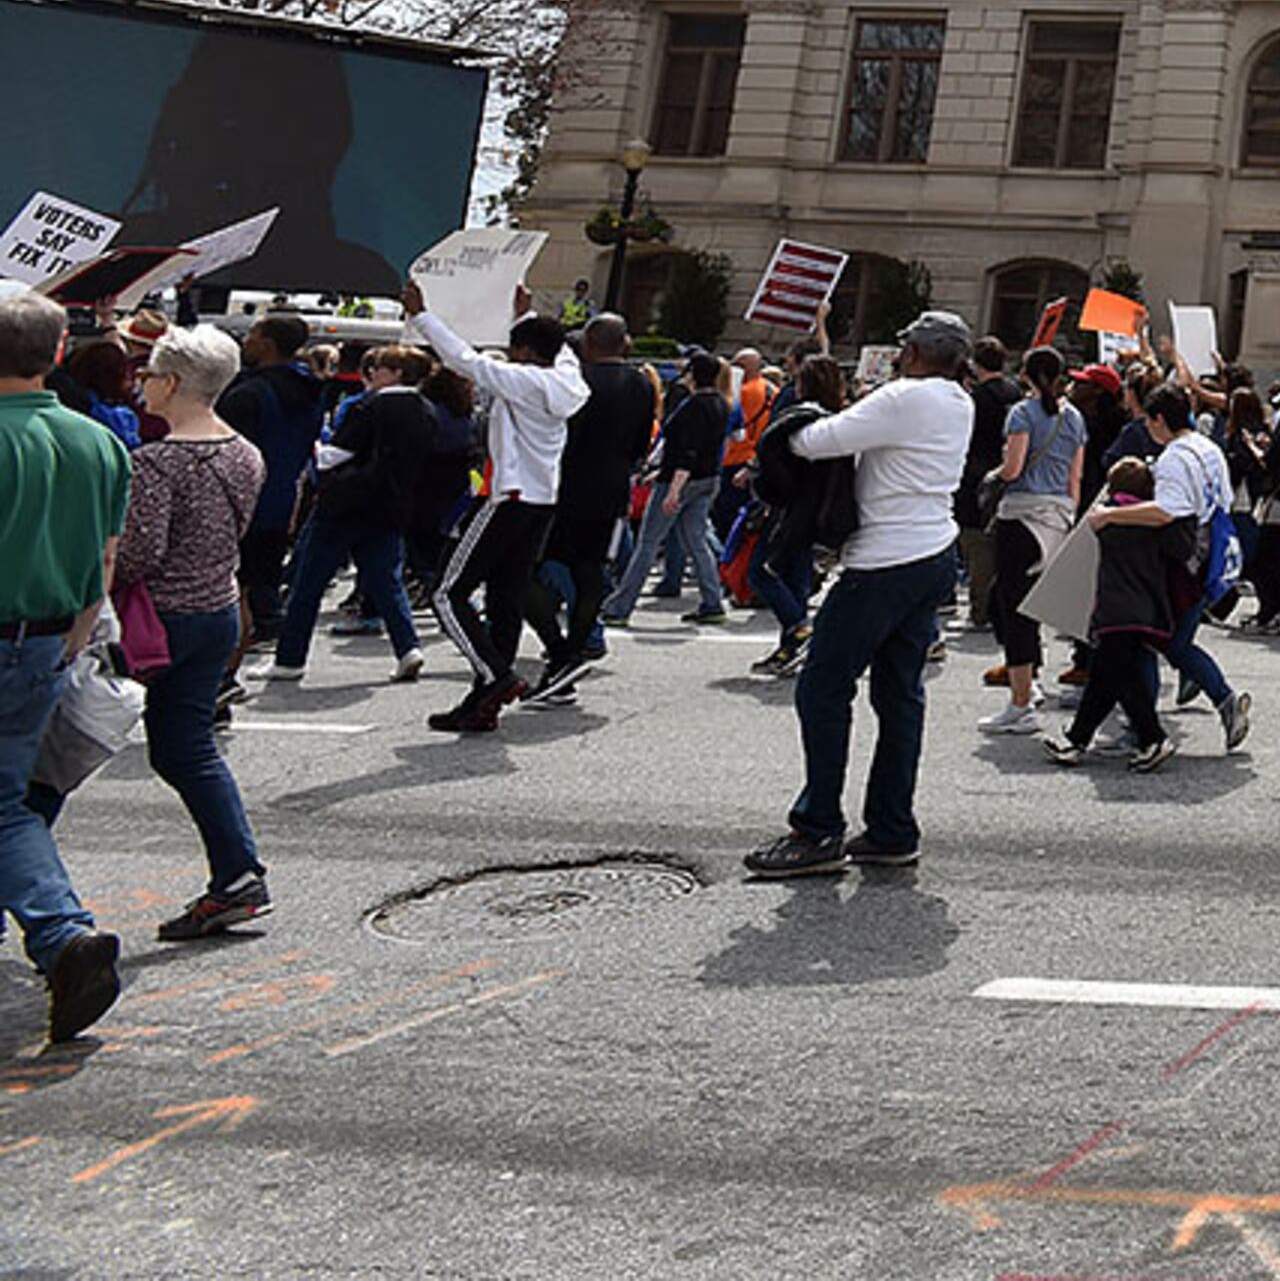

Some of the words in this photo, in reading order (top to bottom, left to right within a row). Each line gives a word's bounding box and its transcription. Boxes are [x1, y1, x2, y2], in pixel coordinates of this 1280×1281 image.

[33, 202, 106, 242] VOTERS
[35, 228, 76, 253] SAY
[45, 256, 72, 274] IT
